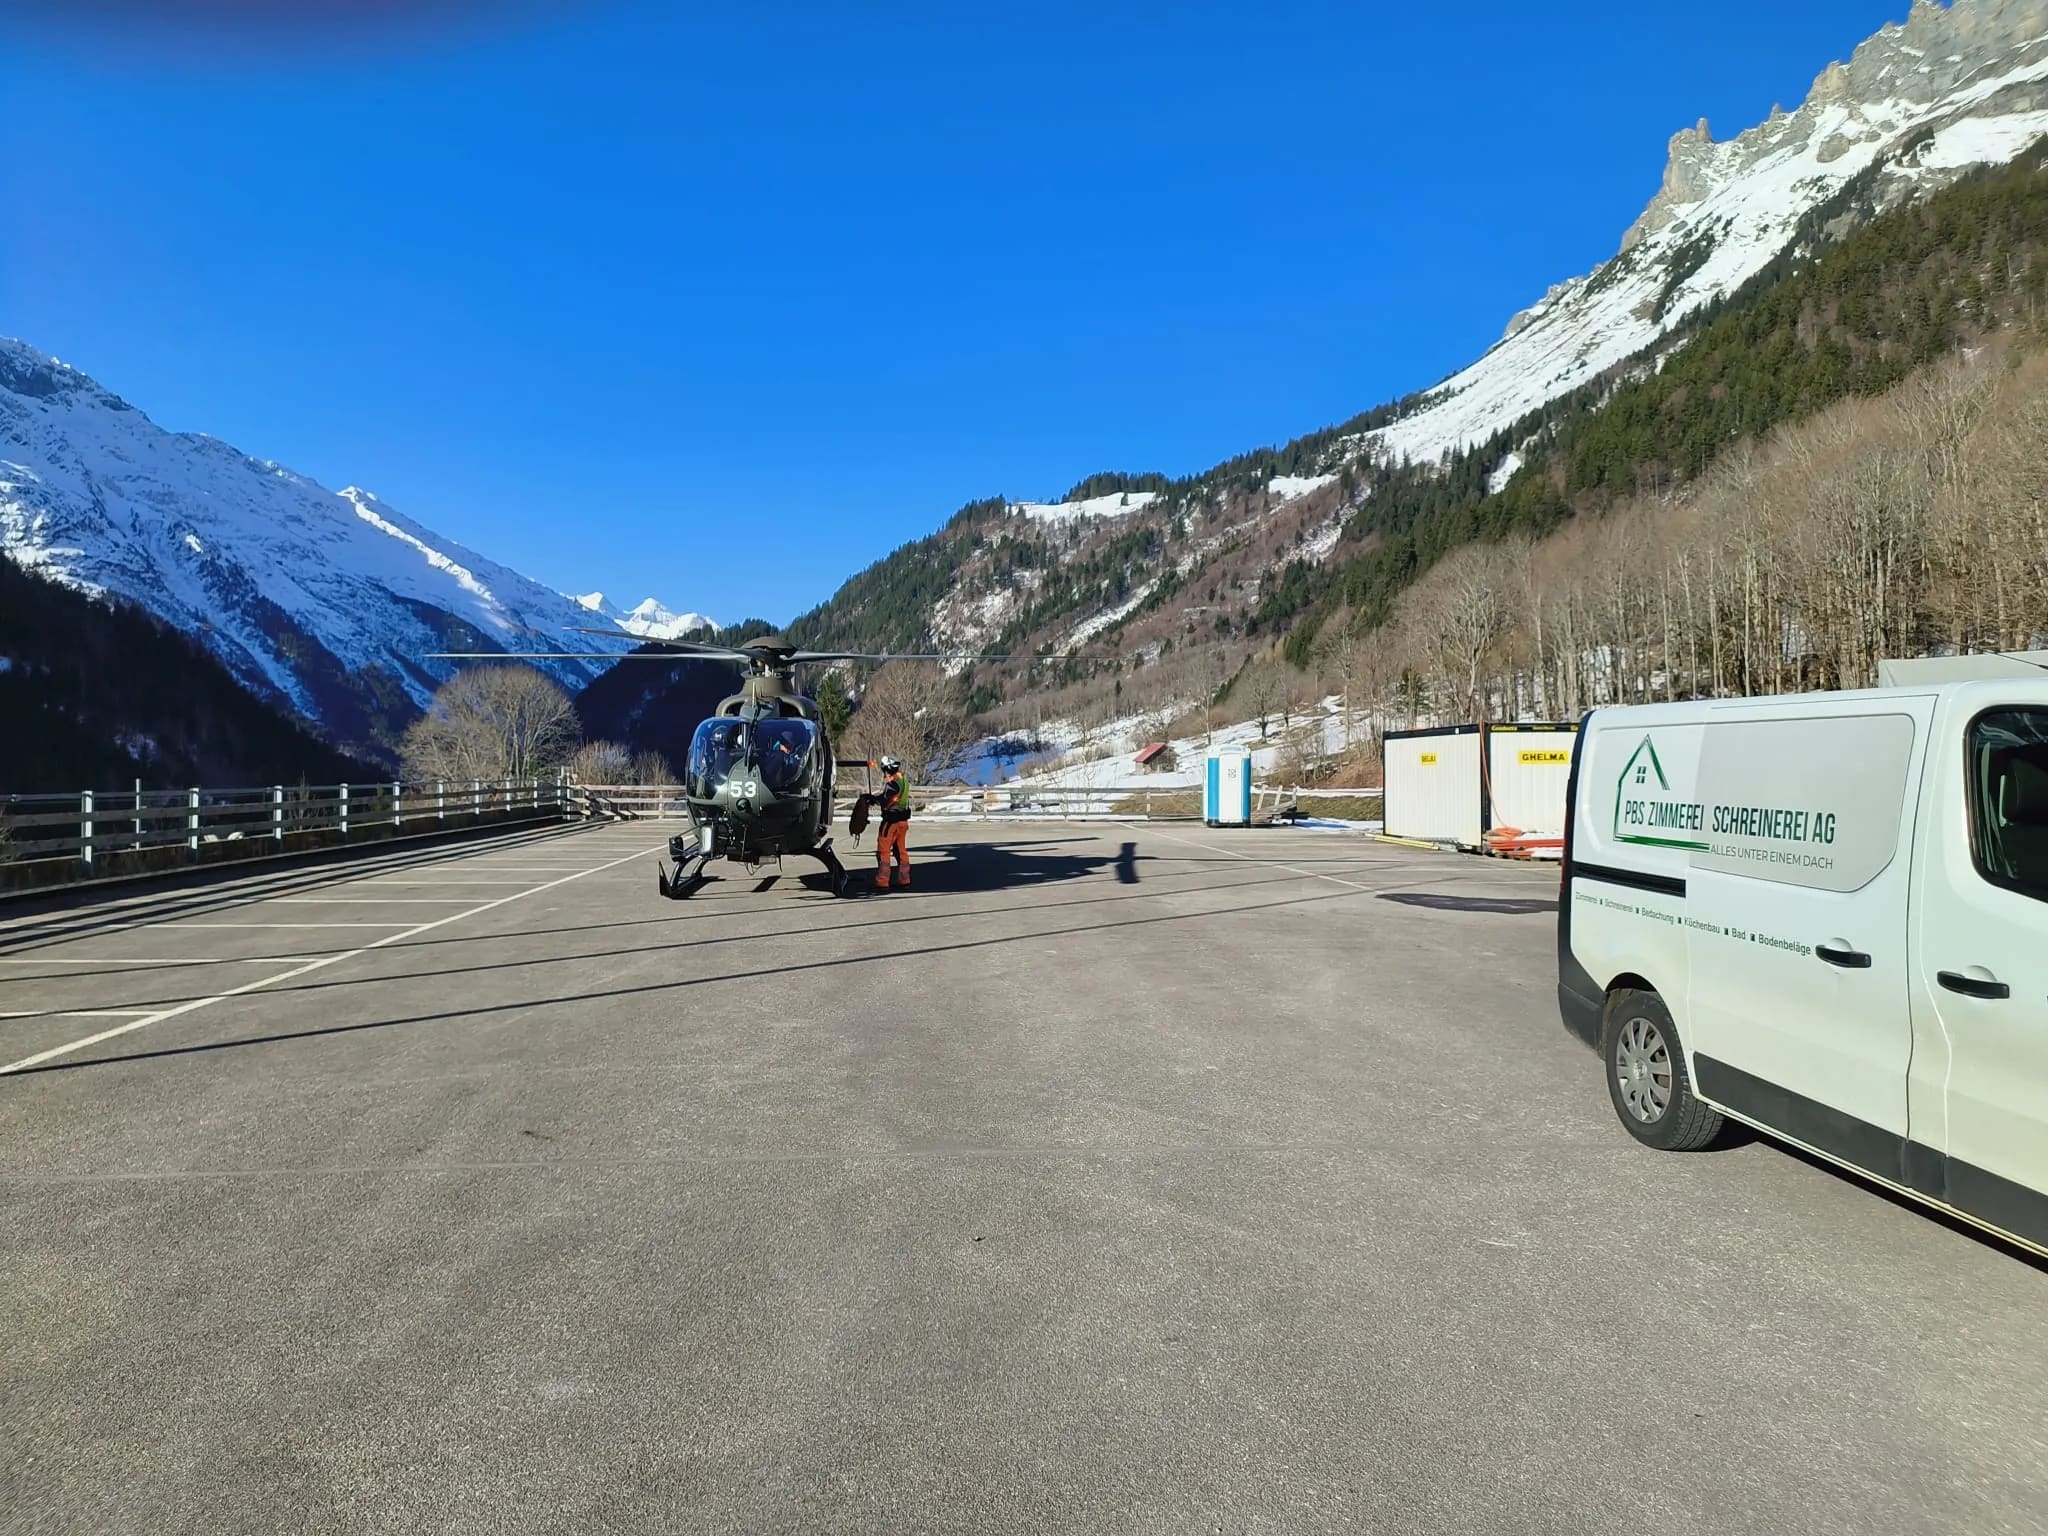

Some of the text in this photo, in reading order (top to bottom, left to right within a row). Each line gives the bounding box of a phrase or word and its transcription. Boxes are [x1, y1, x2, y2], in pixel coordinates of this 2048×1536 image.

[1522, 753, 1565, 761] GHELMA
[730, 780, 757, 798] 53
[1624, 800, 1835, 844] PBS ZIMMEREI SCHREINEREI AG
[1711, 844, 1833, 869] ALLES UNTER EINEM DACH
[1641, 907, 1674, 925] Bedachung
[1684, 916, 1720, 933] Küchenbau
[1731, 928, 1746, 940] Bad
[1759, 934, 1811, 956] Bodenbeläge
